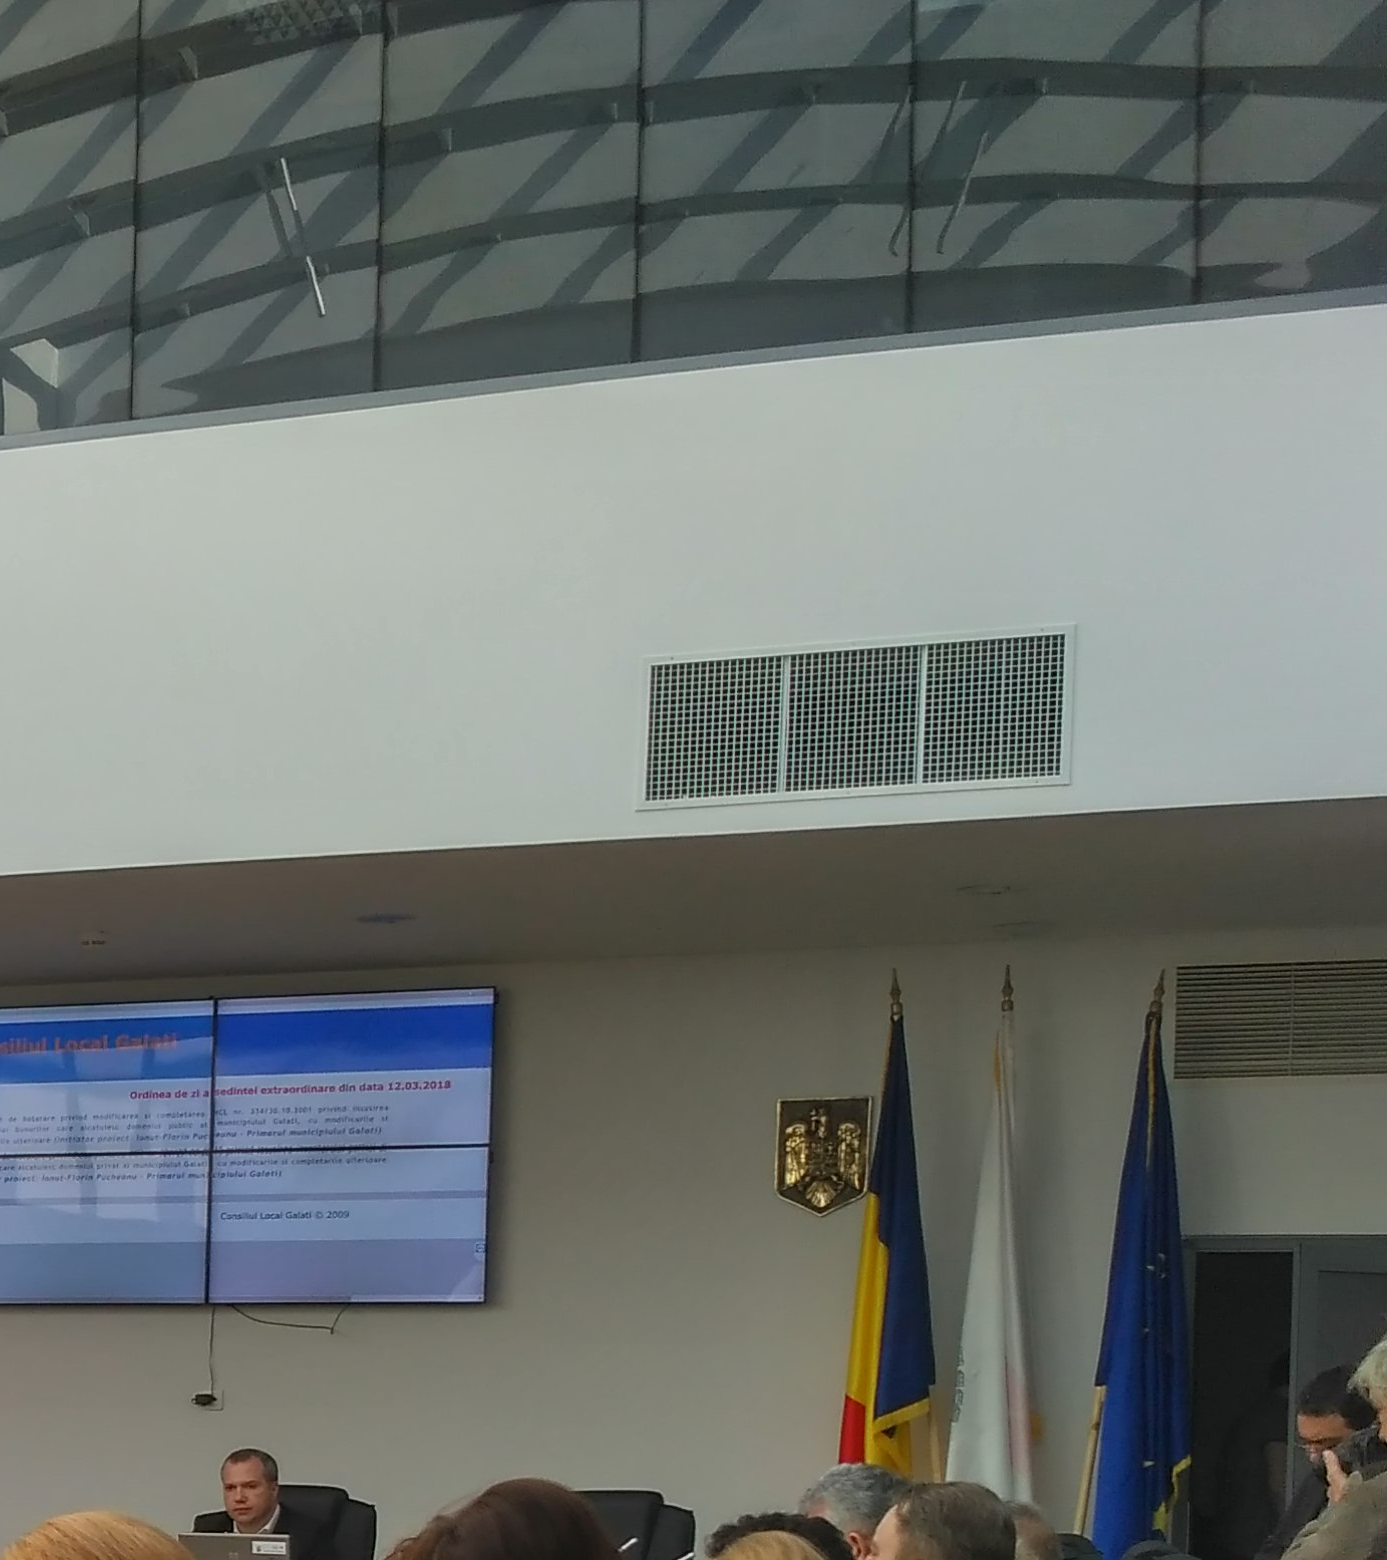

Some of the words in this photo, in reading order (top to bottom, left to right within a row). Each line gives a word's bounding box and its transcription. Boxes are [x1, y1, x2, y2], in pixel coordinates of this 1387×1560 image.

[54, 1035, 109, 1052] Local
[115, 1033, 177, 1049] Galati
[129, 1088, 173, 1100] Ordinea
[174, 1088, 188, 1099] de
[190, 1088, 201, 1098] zi
[203, 1090, 210, 1098] a
[214, 1085, 258, 1097] sedintei
[261, 1084, 336, 1095] extraordinare
[338, 1082, 356, 1093] din
[358, 1081, 384, 1092] data
[387, 1080, 452, 1091] 12.03.2018
[220, 1210, 258, 1221] Consiliul
[258, 1210, 284, 1220] Local
[285, 1210, 312, 1220] Galati
[326, 1210, 350, 1220] 2009
